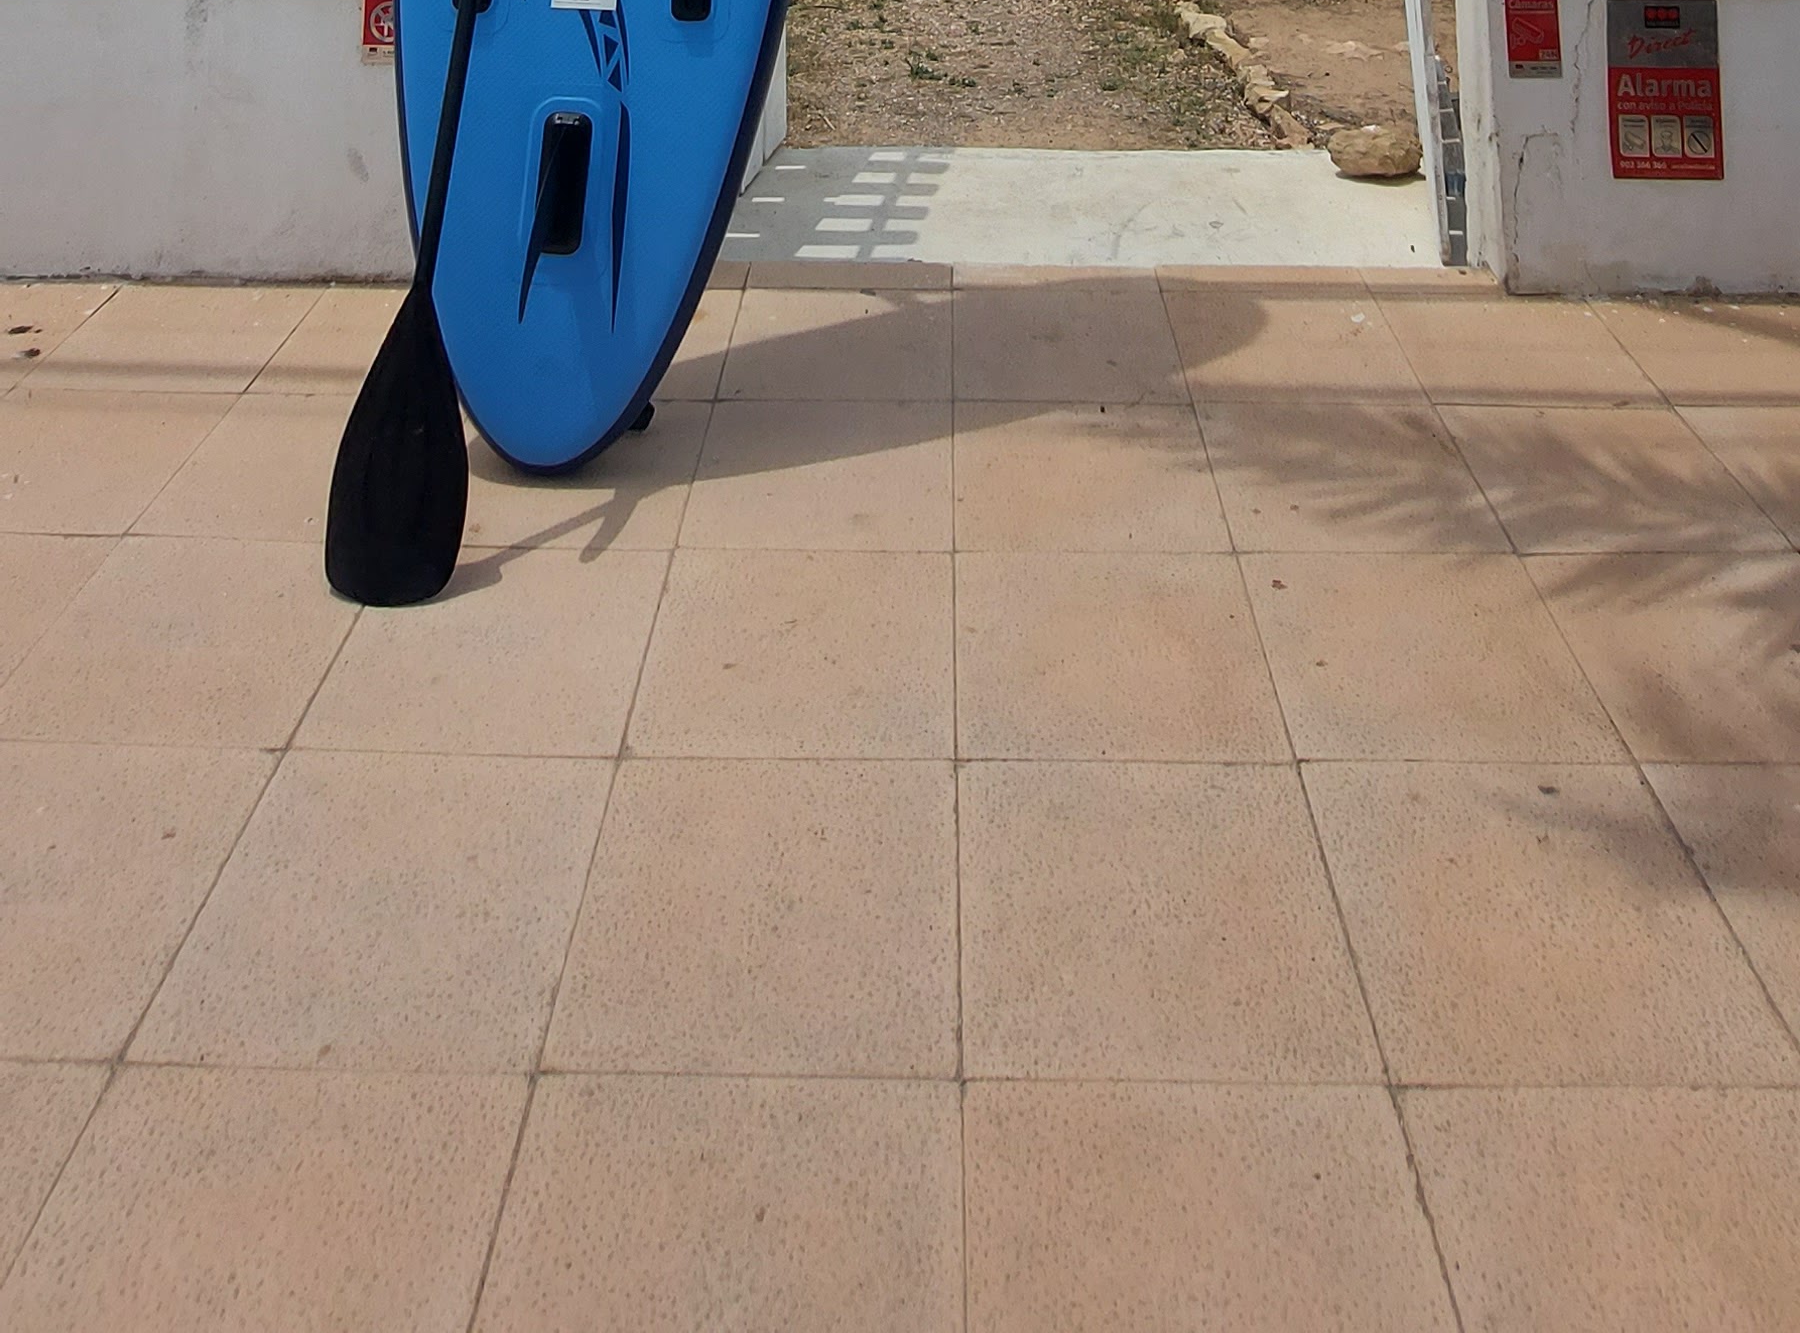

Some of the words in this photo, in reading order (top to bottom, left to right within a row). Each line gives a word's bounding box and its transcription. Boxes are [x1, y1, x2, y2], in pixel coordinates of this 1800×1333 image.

[1627, 27, 1697, 59] Direct
[1617, 73, 1712, 97] Alarma
[1617, 101, 1637, 110] con
[1668, 102, 1676, 110] a
